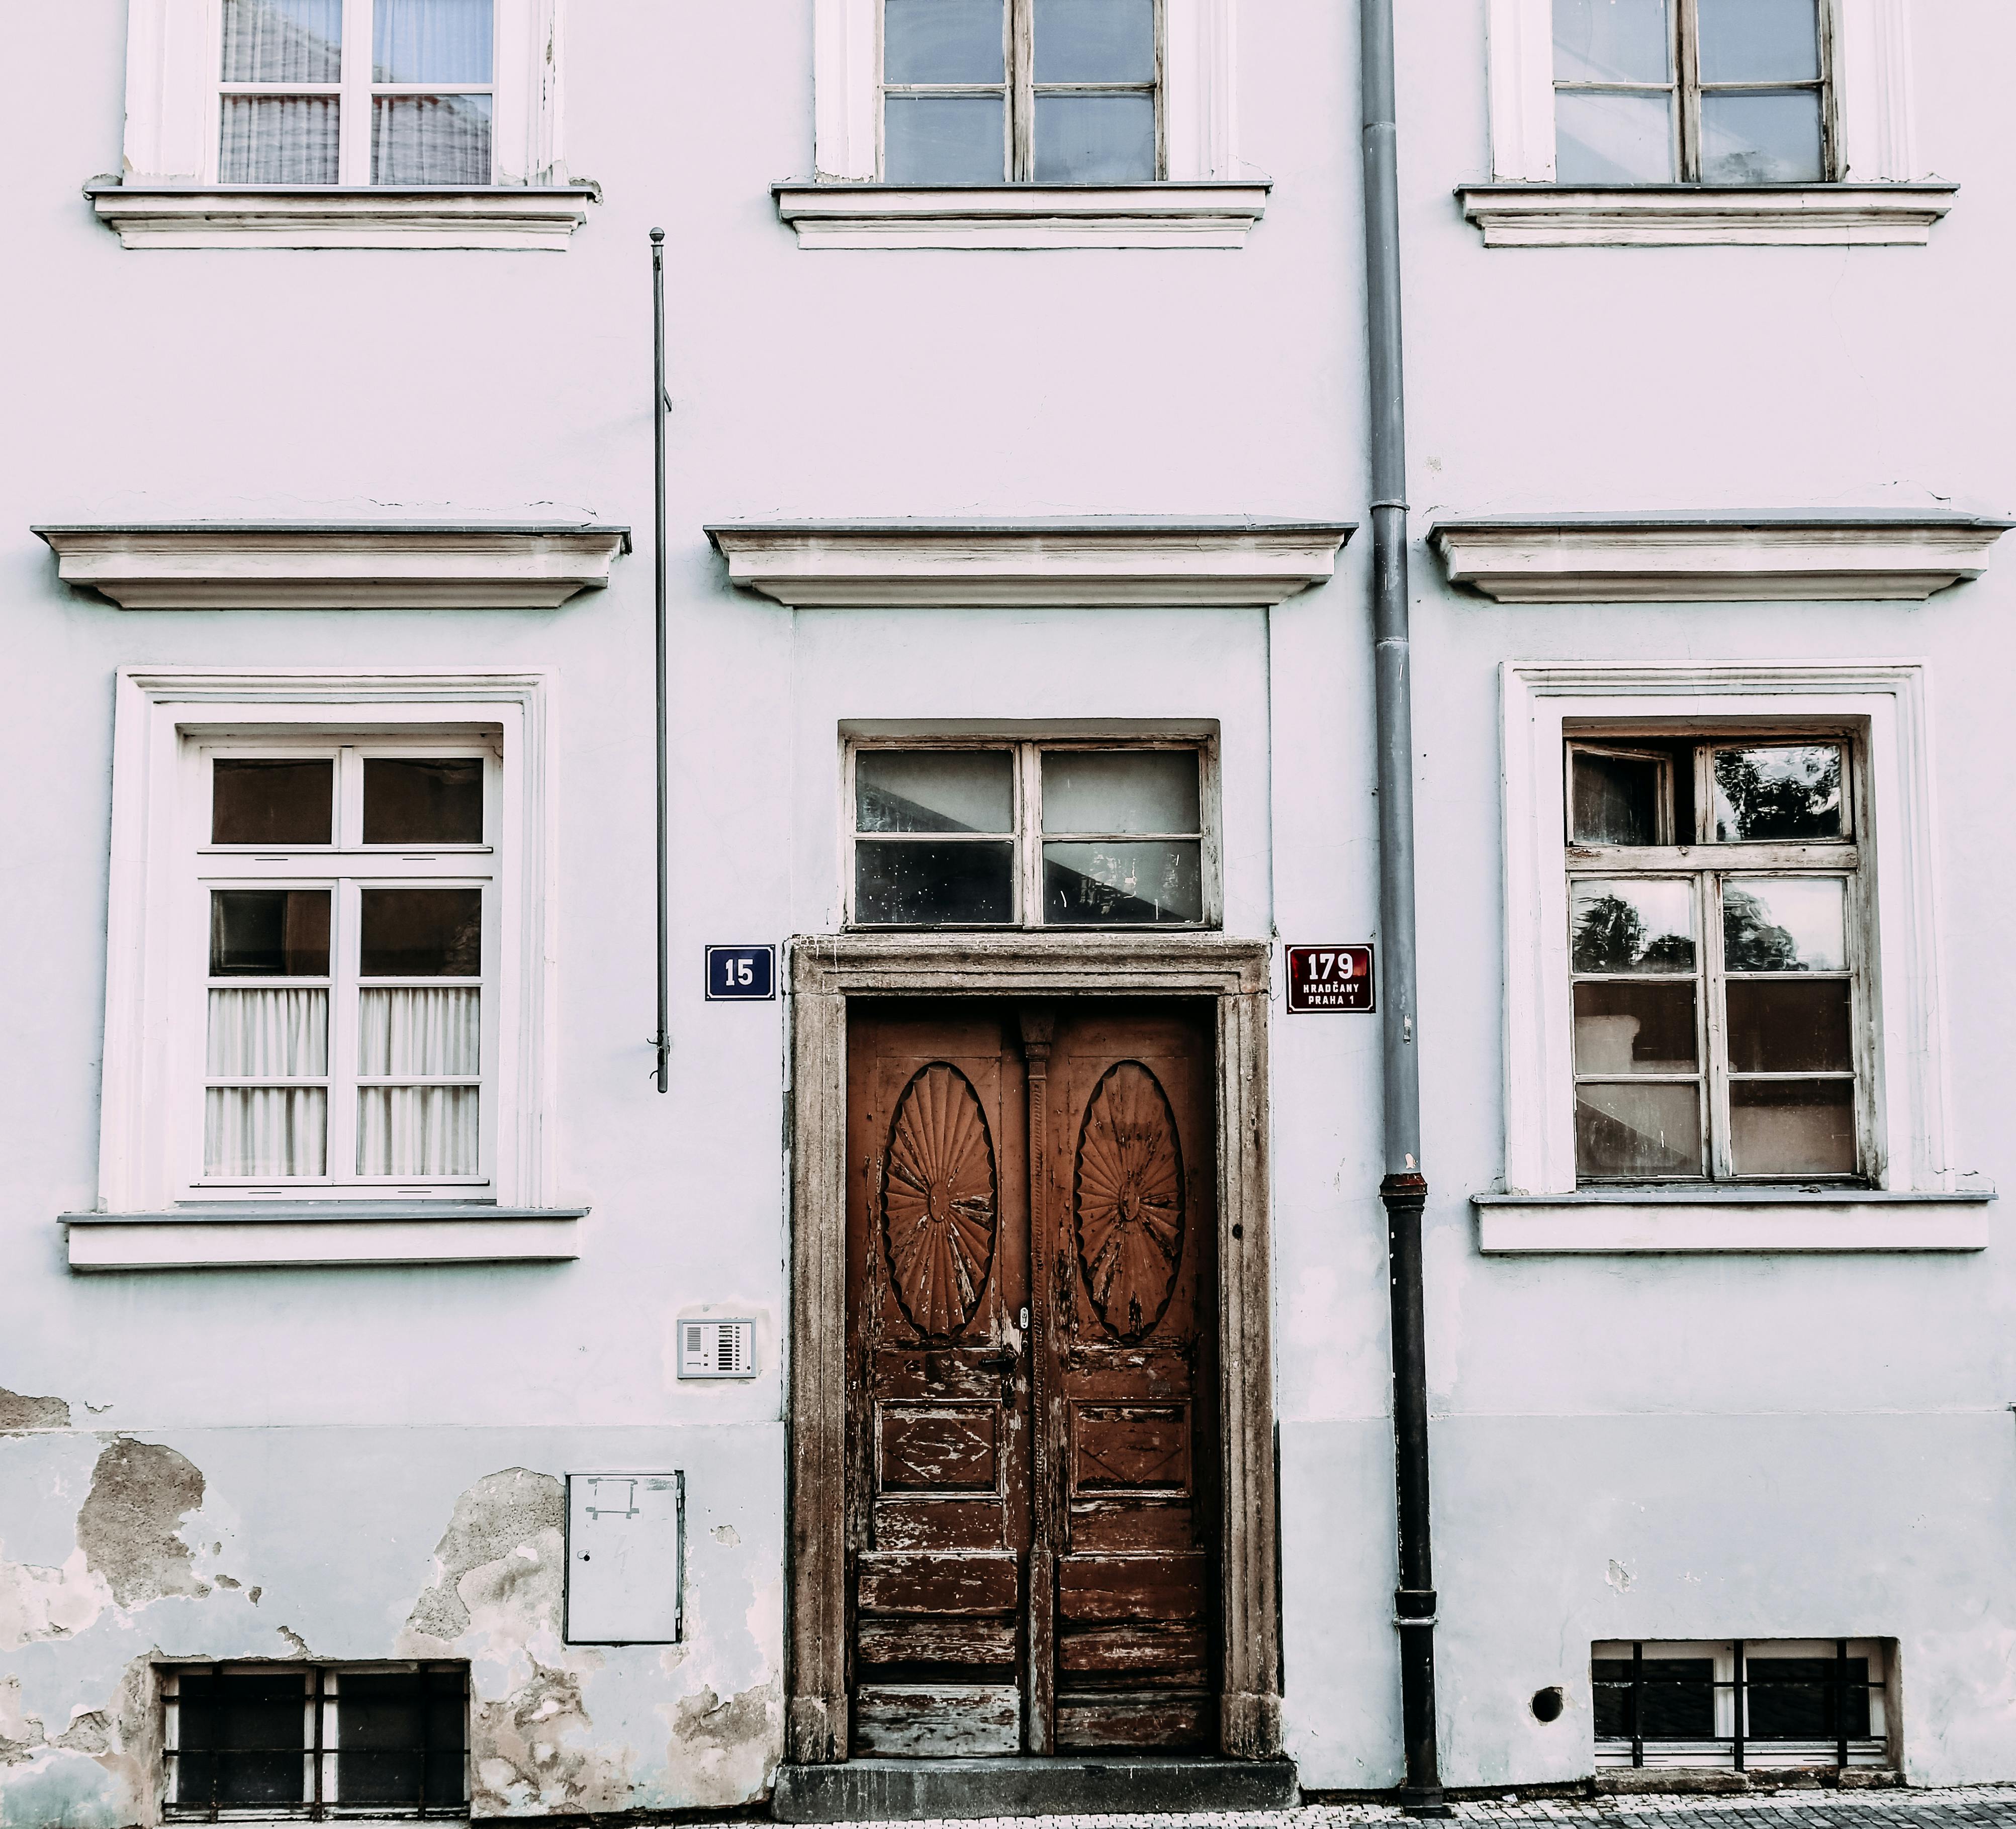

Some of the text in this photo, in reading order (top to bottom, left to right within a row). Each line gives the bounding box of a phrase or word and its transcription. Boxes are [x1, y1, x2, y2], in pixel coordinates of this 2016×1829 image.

[725, 959, 753, 986] 15
[1309, 953, 1353, 980] 179
[1304, 981, 1359, 993] HRADČANY
[1309, 995, 1354, 1004] PRAHA 1
